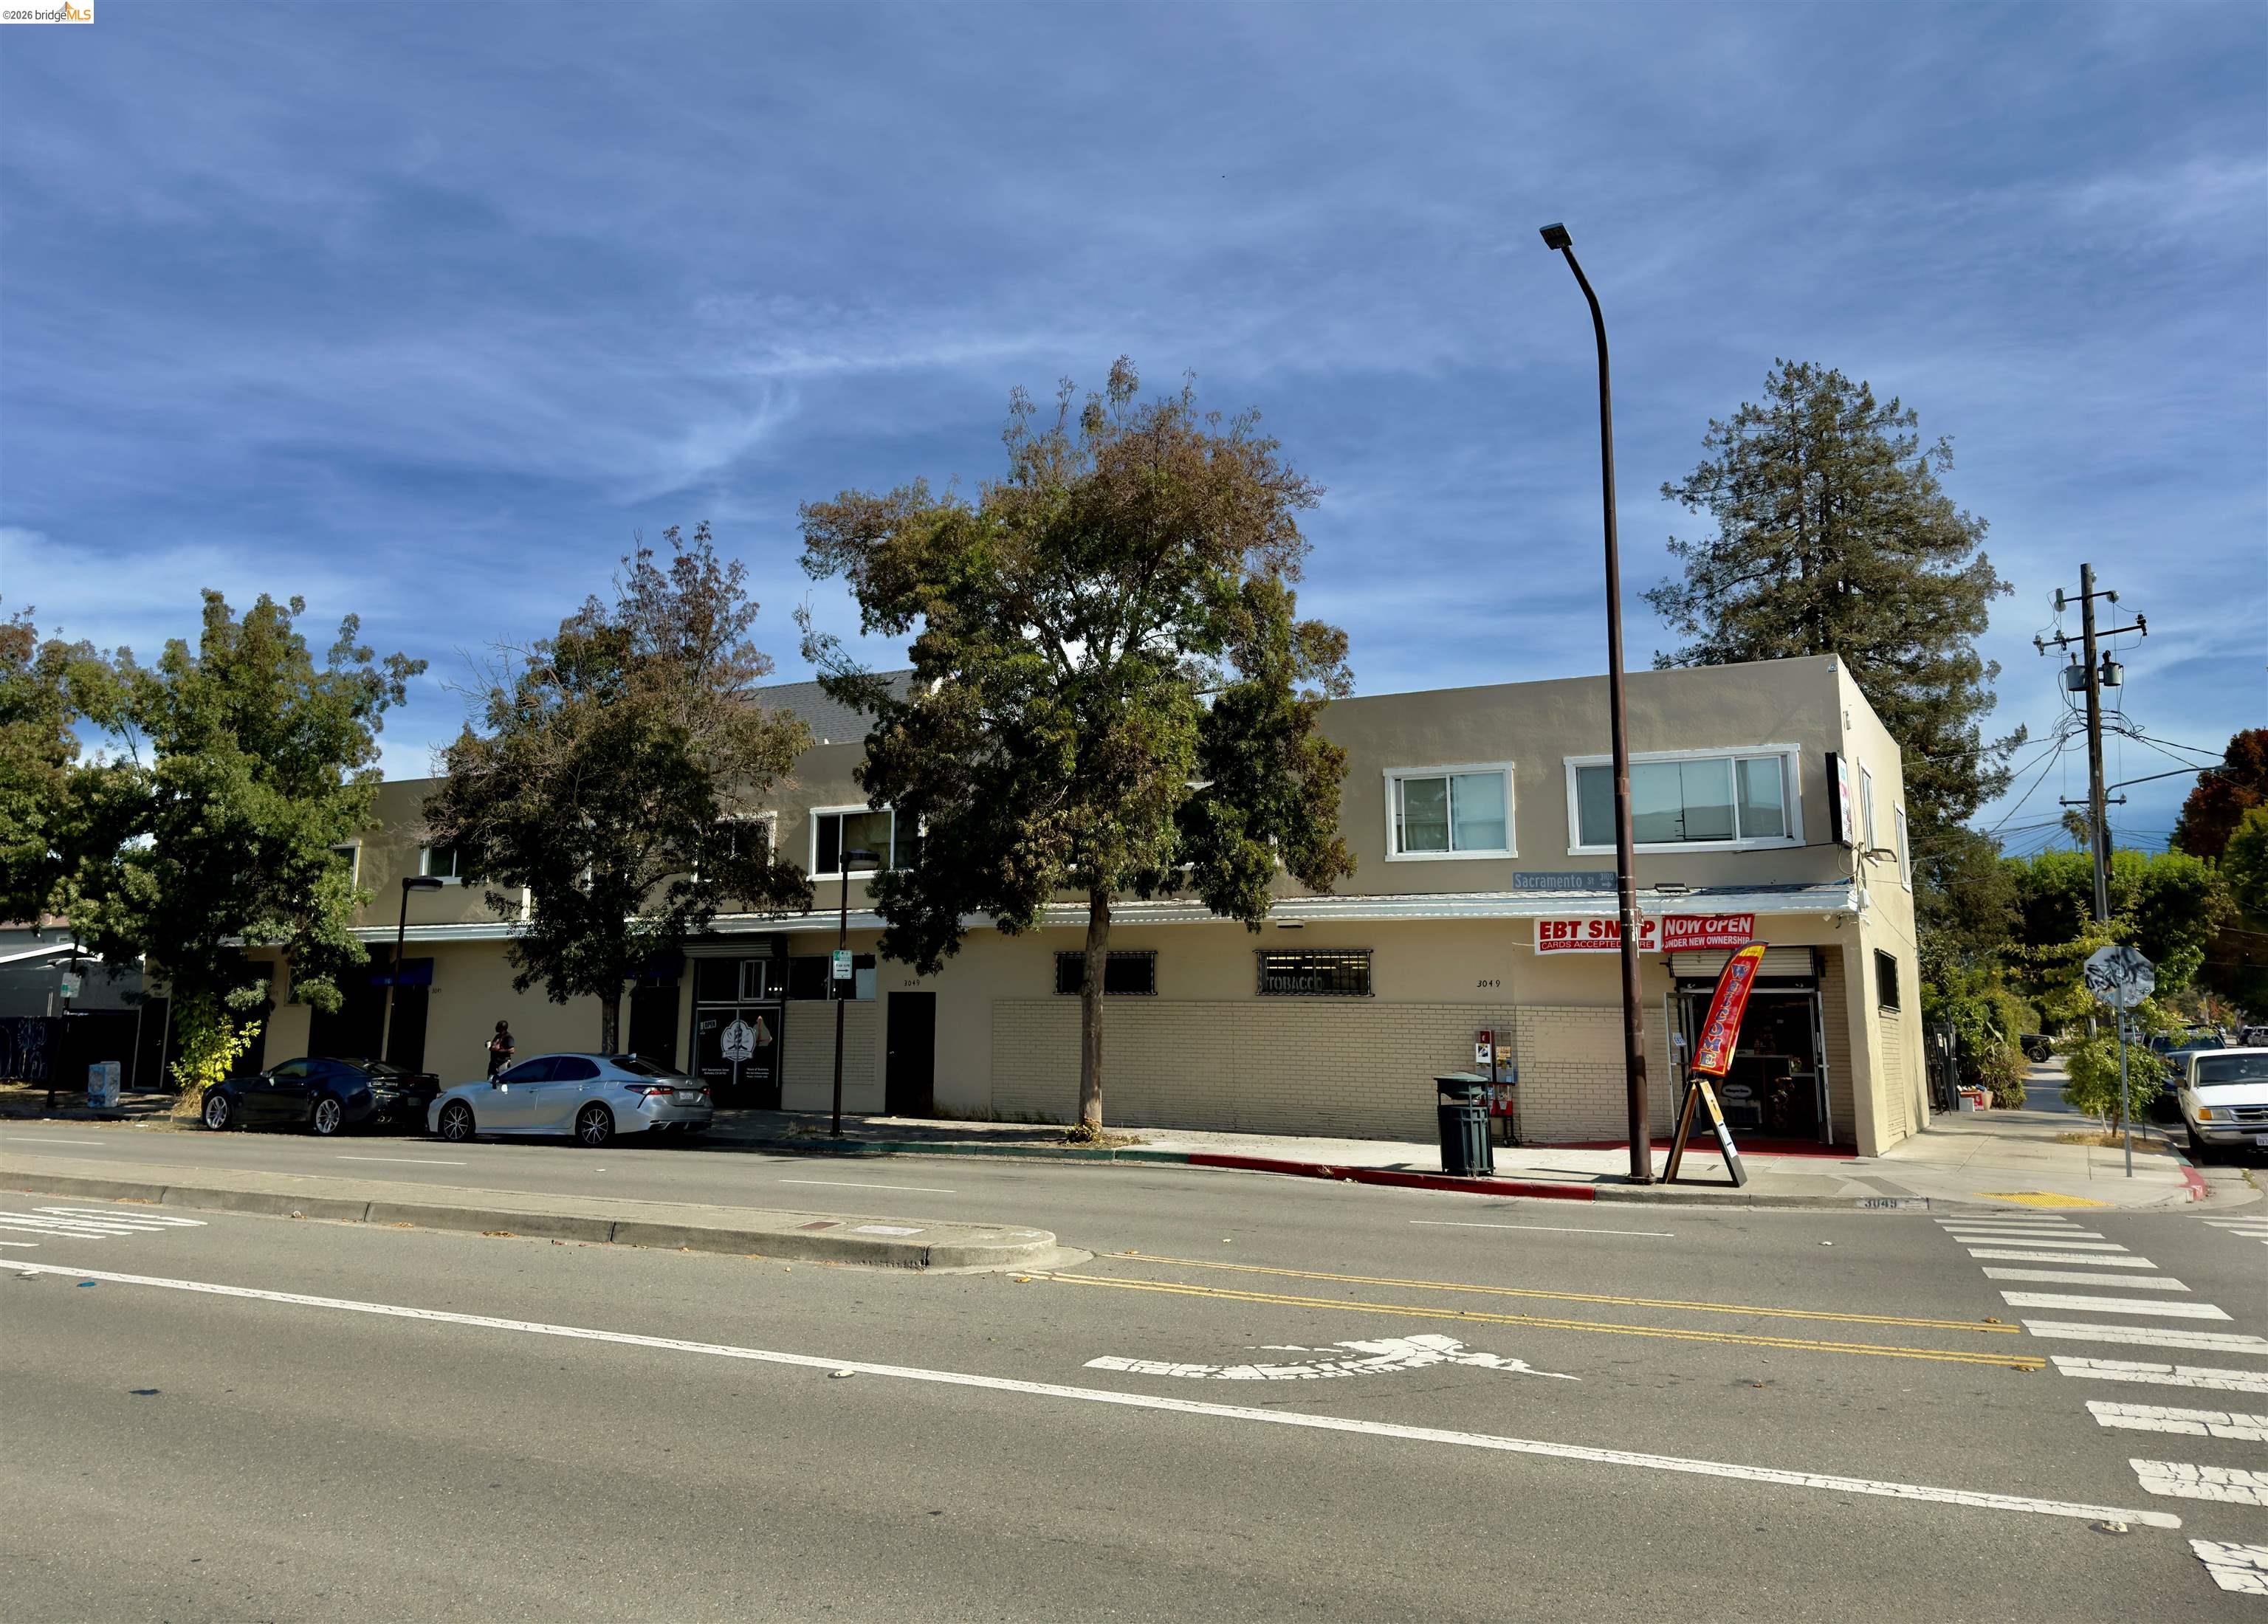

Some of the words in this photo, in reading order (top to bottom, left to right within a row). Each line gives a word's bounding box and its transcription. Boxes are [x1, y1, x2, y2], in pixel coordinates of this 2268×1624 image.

[1515, 874, 1582, 887] Sacramento
[1540, 921, 1581, 940] EBT
[1588, 920, 1655, 939] SNP
[1665, 919, 1702, 937] NOW
[1705, 917, 1751, 934] OPEN
[1542, 941, 1571, 950] CARDS
[1574, 940, 1621, 949] ACCEPTED
[1665, 938, 1688, 949] UNDER
[1689, 937, 1705, 946] NEW
[1706, 935, 1750, 945] OWNERSHIP
[1267, 976, 1323, 990] TOBACCO
[1700, 963, 1750, 1068] WELCOME
[1864, 1199, 1897, 1208] 3049
